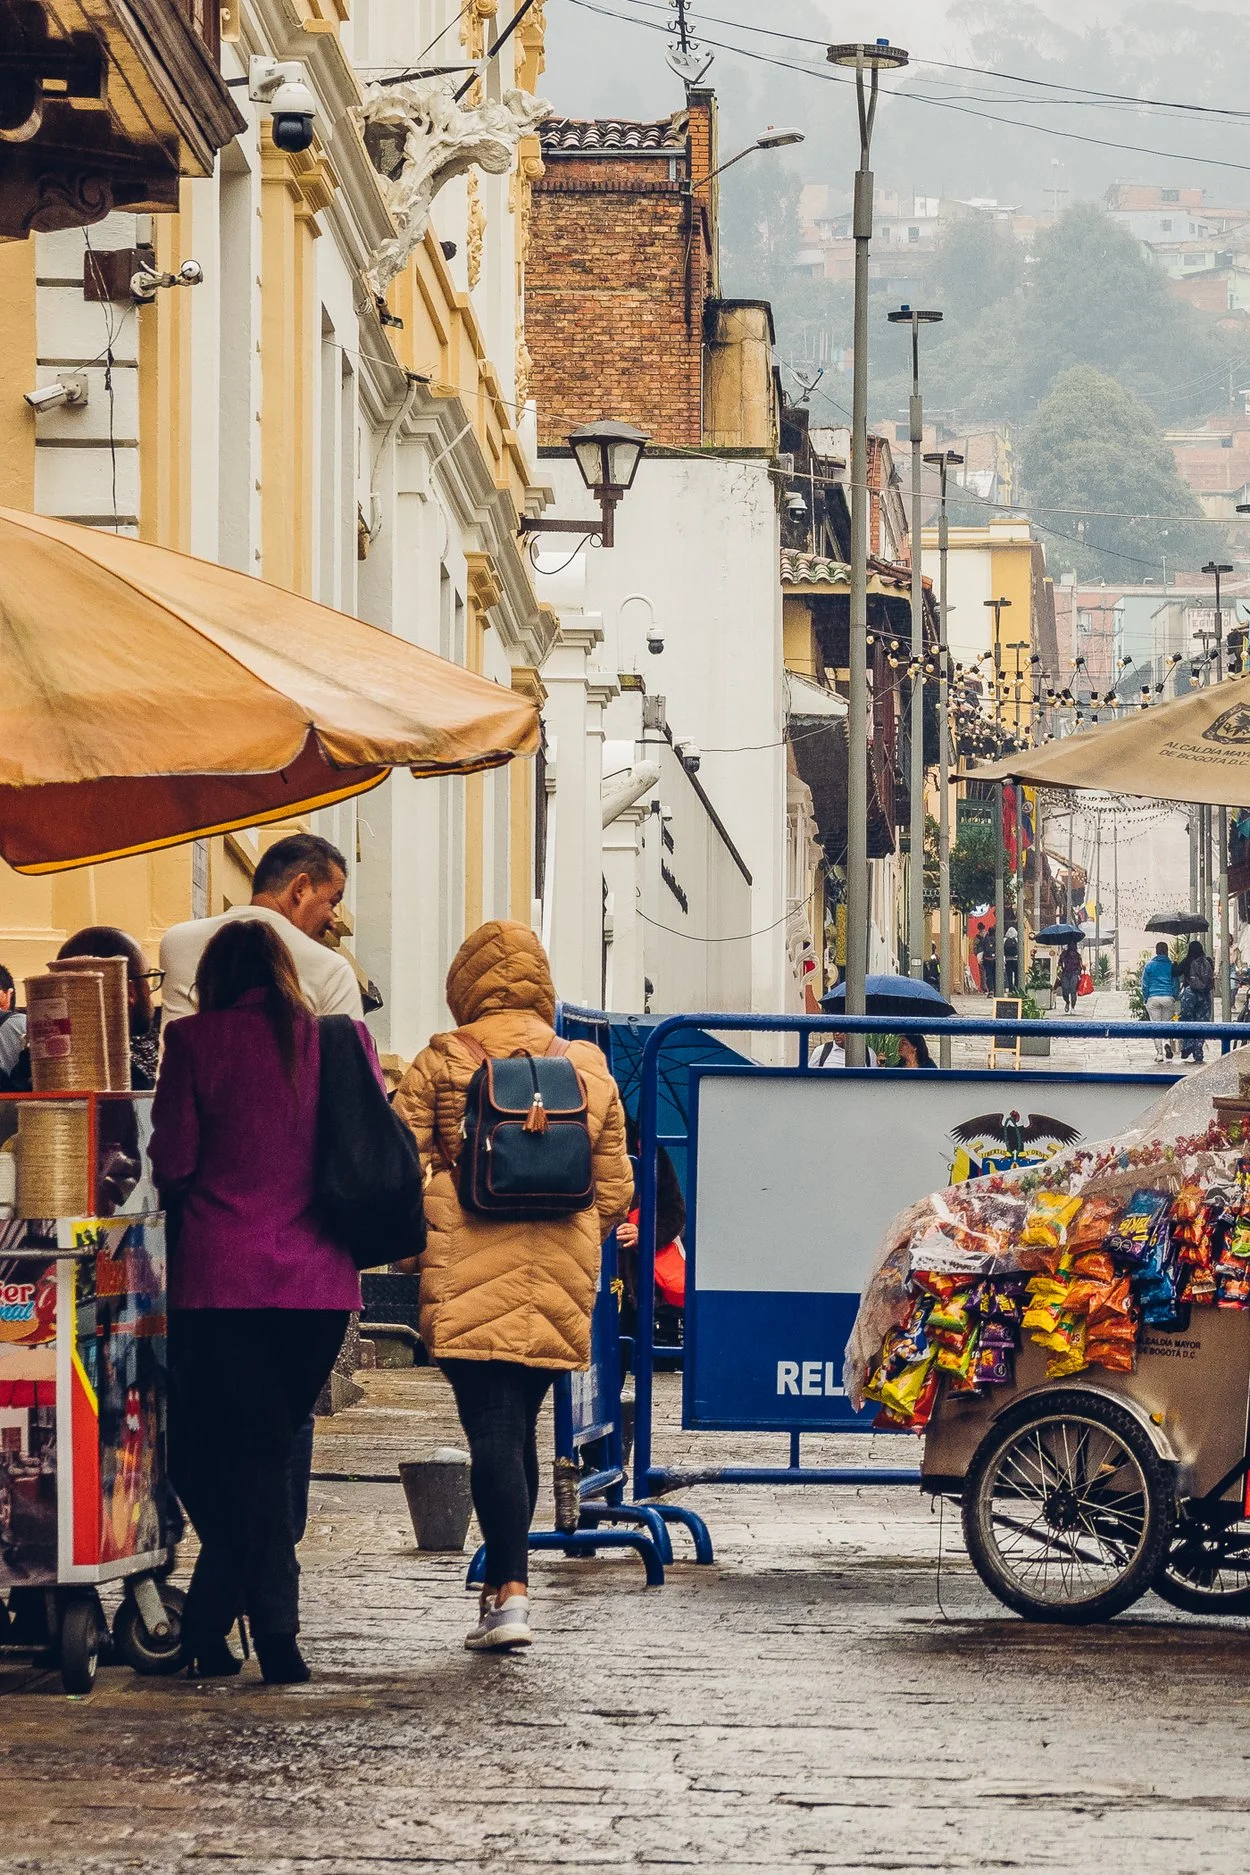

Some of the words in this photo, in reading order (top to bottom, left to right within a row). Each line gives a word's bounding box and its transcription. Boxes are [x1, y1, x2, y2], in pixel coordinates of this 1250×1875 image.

[1159, 749, 1178, 757] DE
[1174, 1339, 1201, 1350] MAYOR
[777, 1361, 848, 1396] REL
